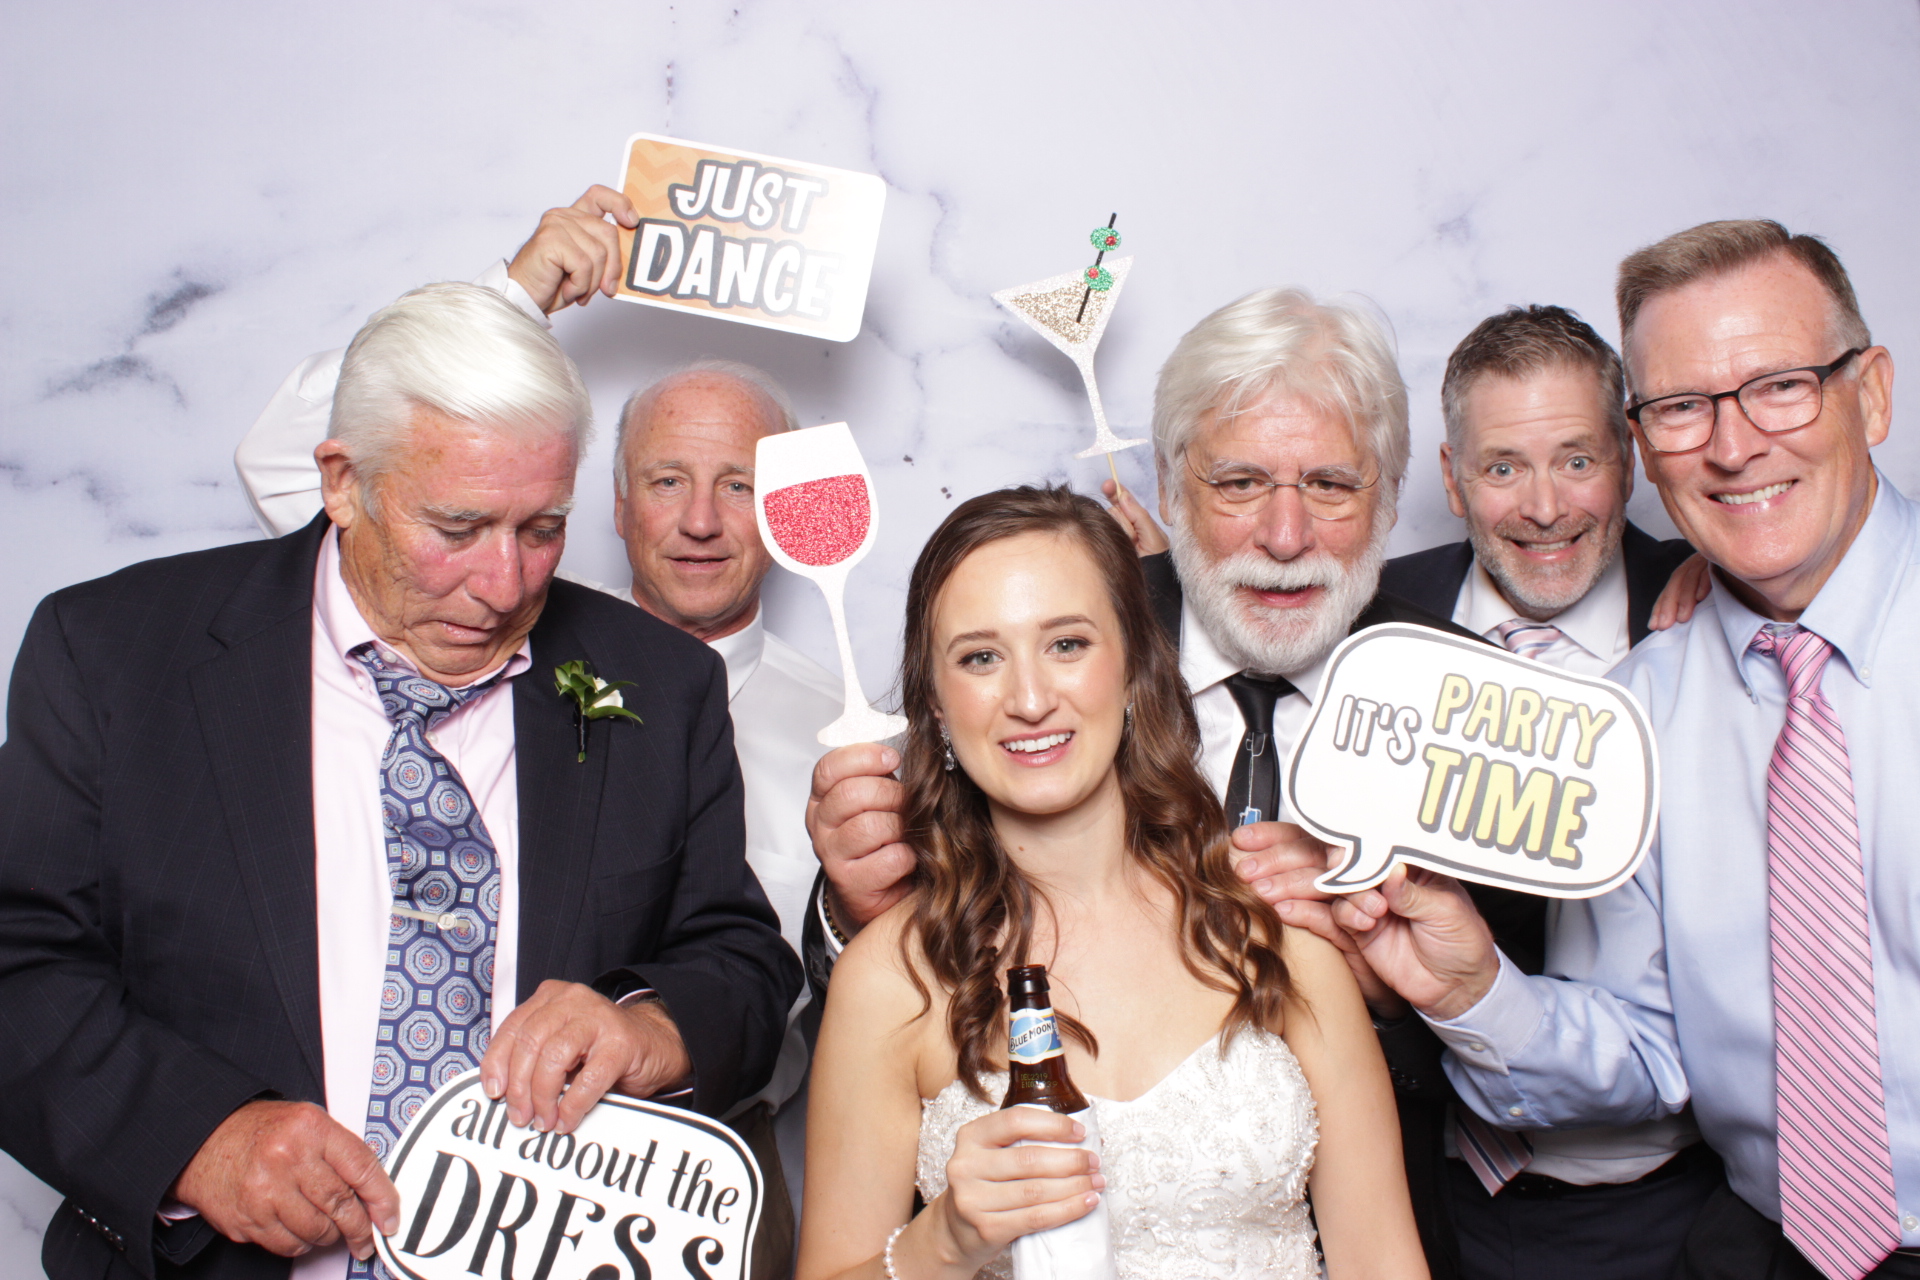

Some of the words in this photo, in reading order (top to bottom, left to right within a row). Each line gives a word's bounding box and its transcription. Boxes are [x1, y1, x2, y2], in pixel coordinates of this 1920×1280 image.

[669, 160, 828, 234] JUST
[626, 218, 845, 320] DANCE
[1333, 695, 1422, 765] IT'S
[1432, 673, 1616, 768] PARTY
[1417, 743, 1597, 869] TIME
[1010, 1033, 1028, 1051] BLUE
[1029, 1022, 1051, 1039] MOON
[451, 1098, 509, 1150] all
[518, 1121, 659, 1197] about
[667, 1150, 739, 1224] the
